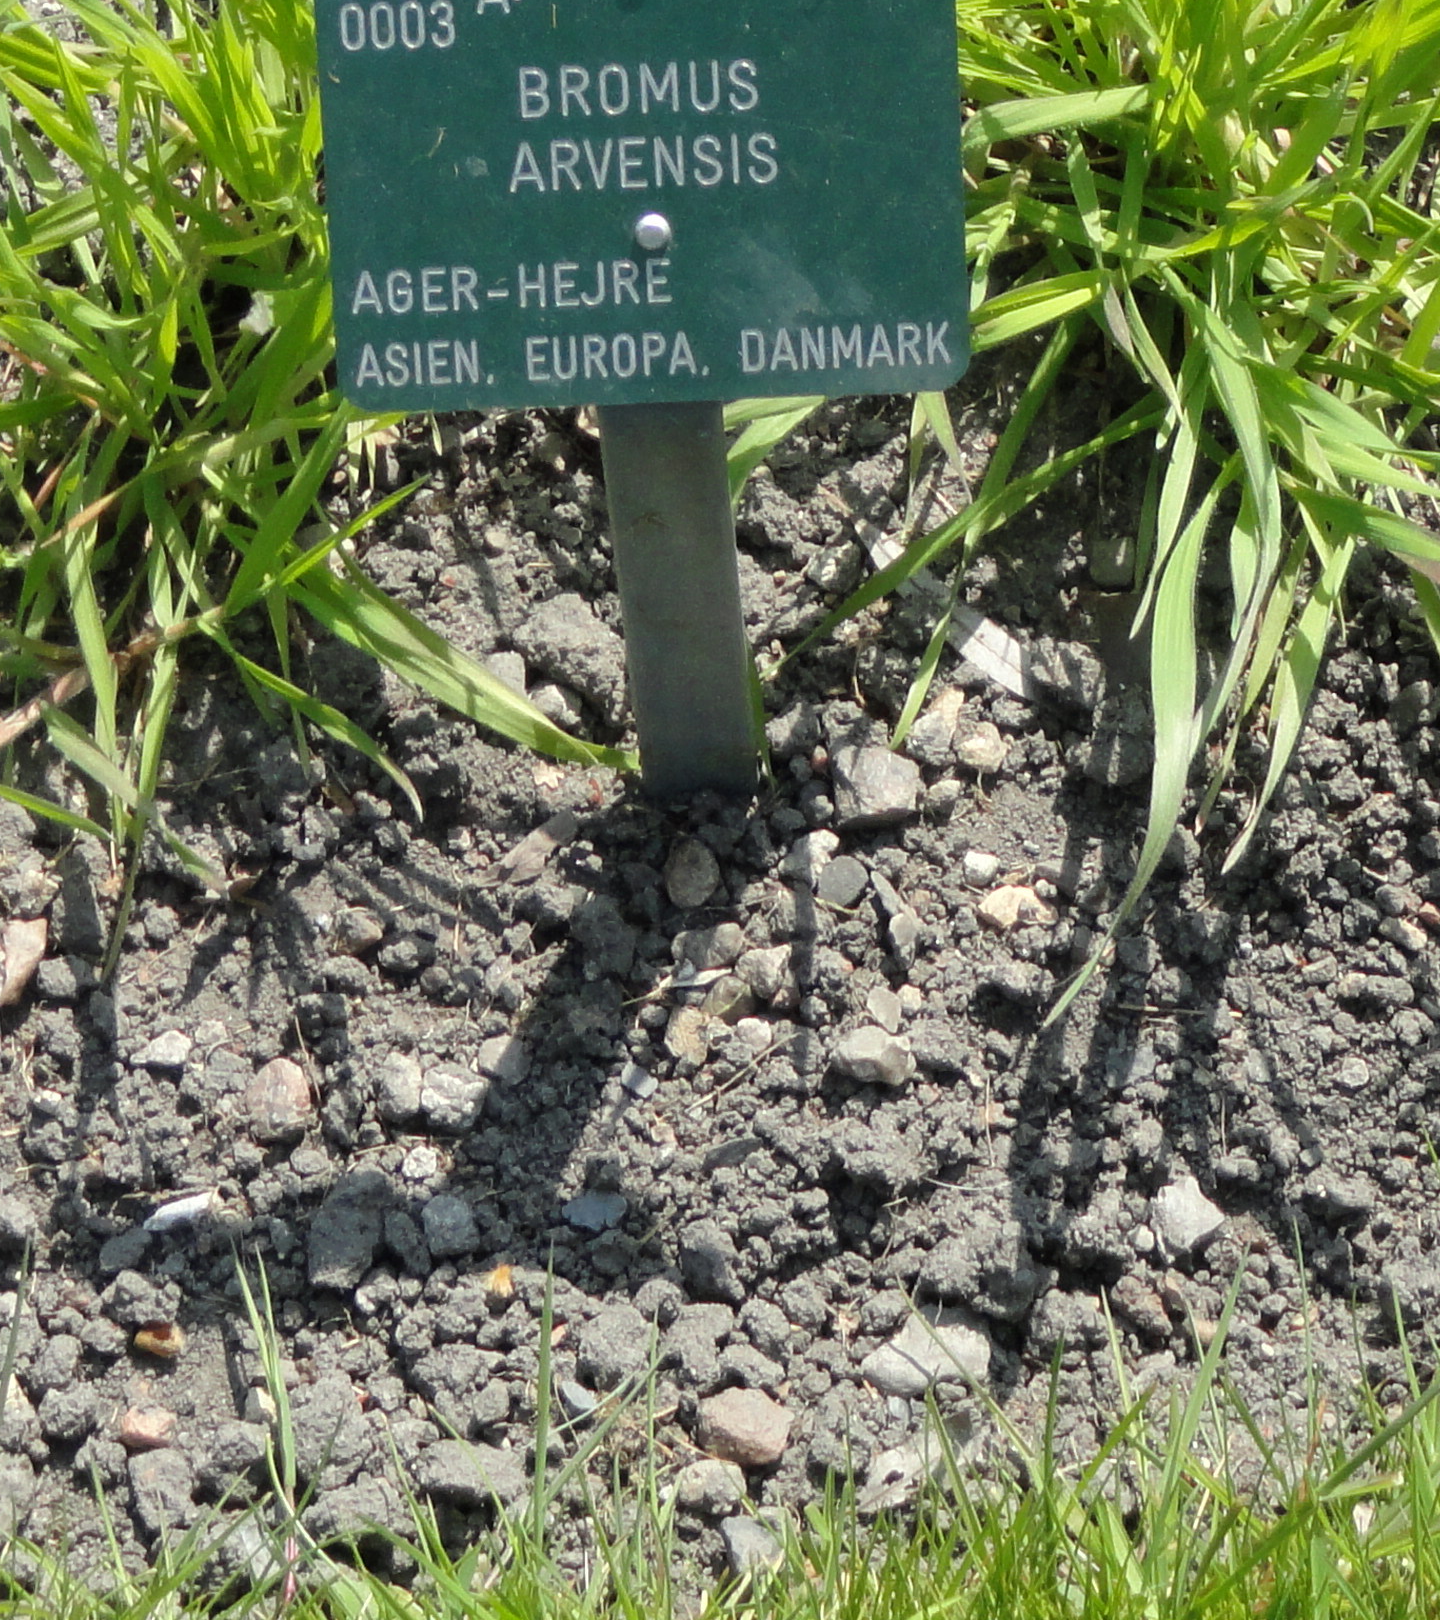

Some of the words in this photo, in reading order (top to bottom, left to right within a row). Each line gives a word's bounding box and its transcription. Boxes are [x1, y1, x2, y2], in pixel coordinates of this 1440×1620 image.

[339, 0, 456, 51] 0003
[517, 58, 761, 119] BROMUS
[509, 133, 779, 193] ARVENSIS
[352, 259, 673, 315] AGER-HEJRE
[739, 322, 952, 374] DANMARK
